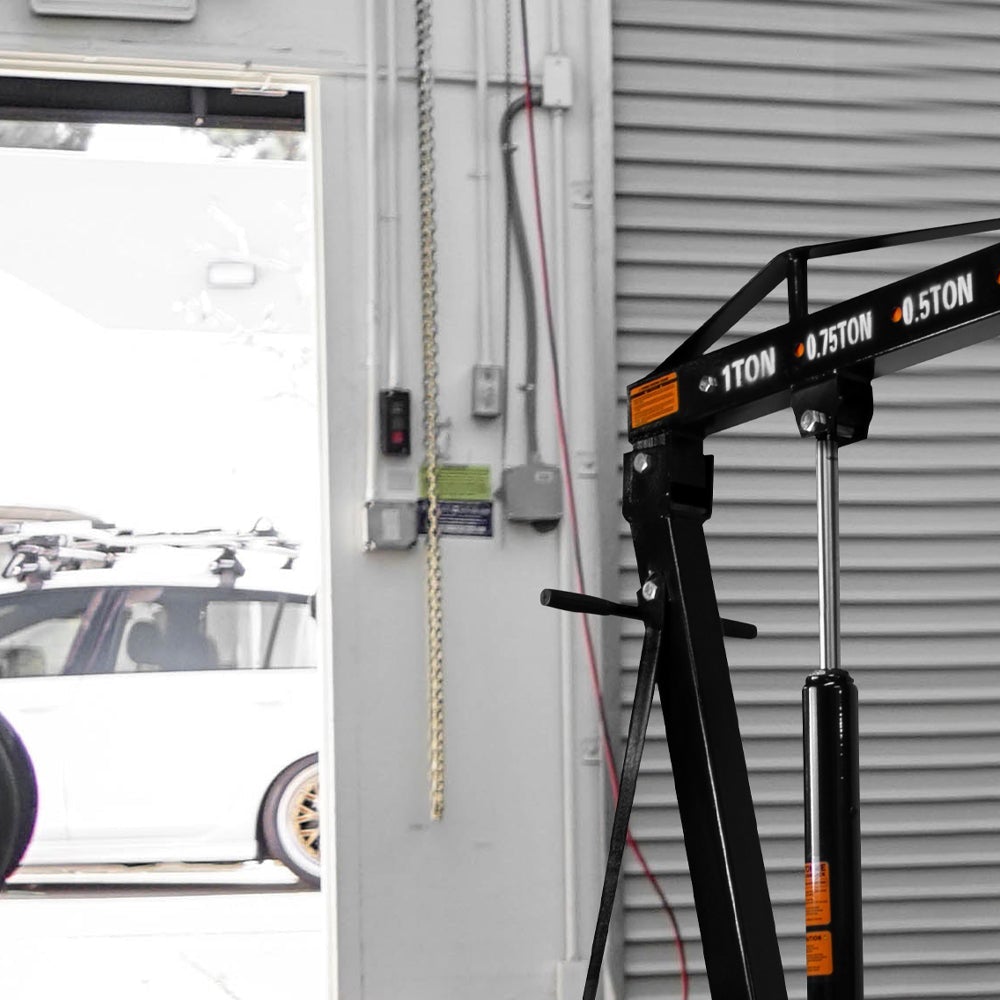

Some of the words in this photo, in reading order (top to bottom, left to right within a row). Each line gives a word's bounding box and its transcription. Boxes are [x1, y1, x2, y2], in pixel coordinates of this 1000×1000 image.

[722, 346, 776, 392] 1TON
[806, 310, 873, 362] 0.75TON
[903, 272, 974, 326] 0.5TON
